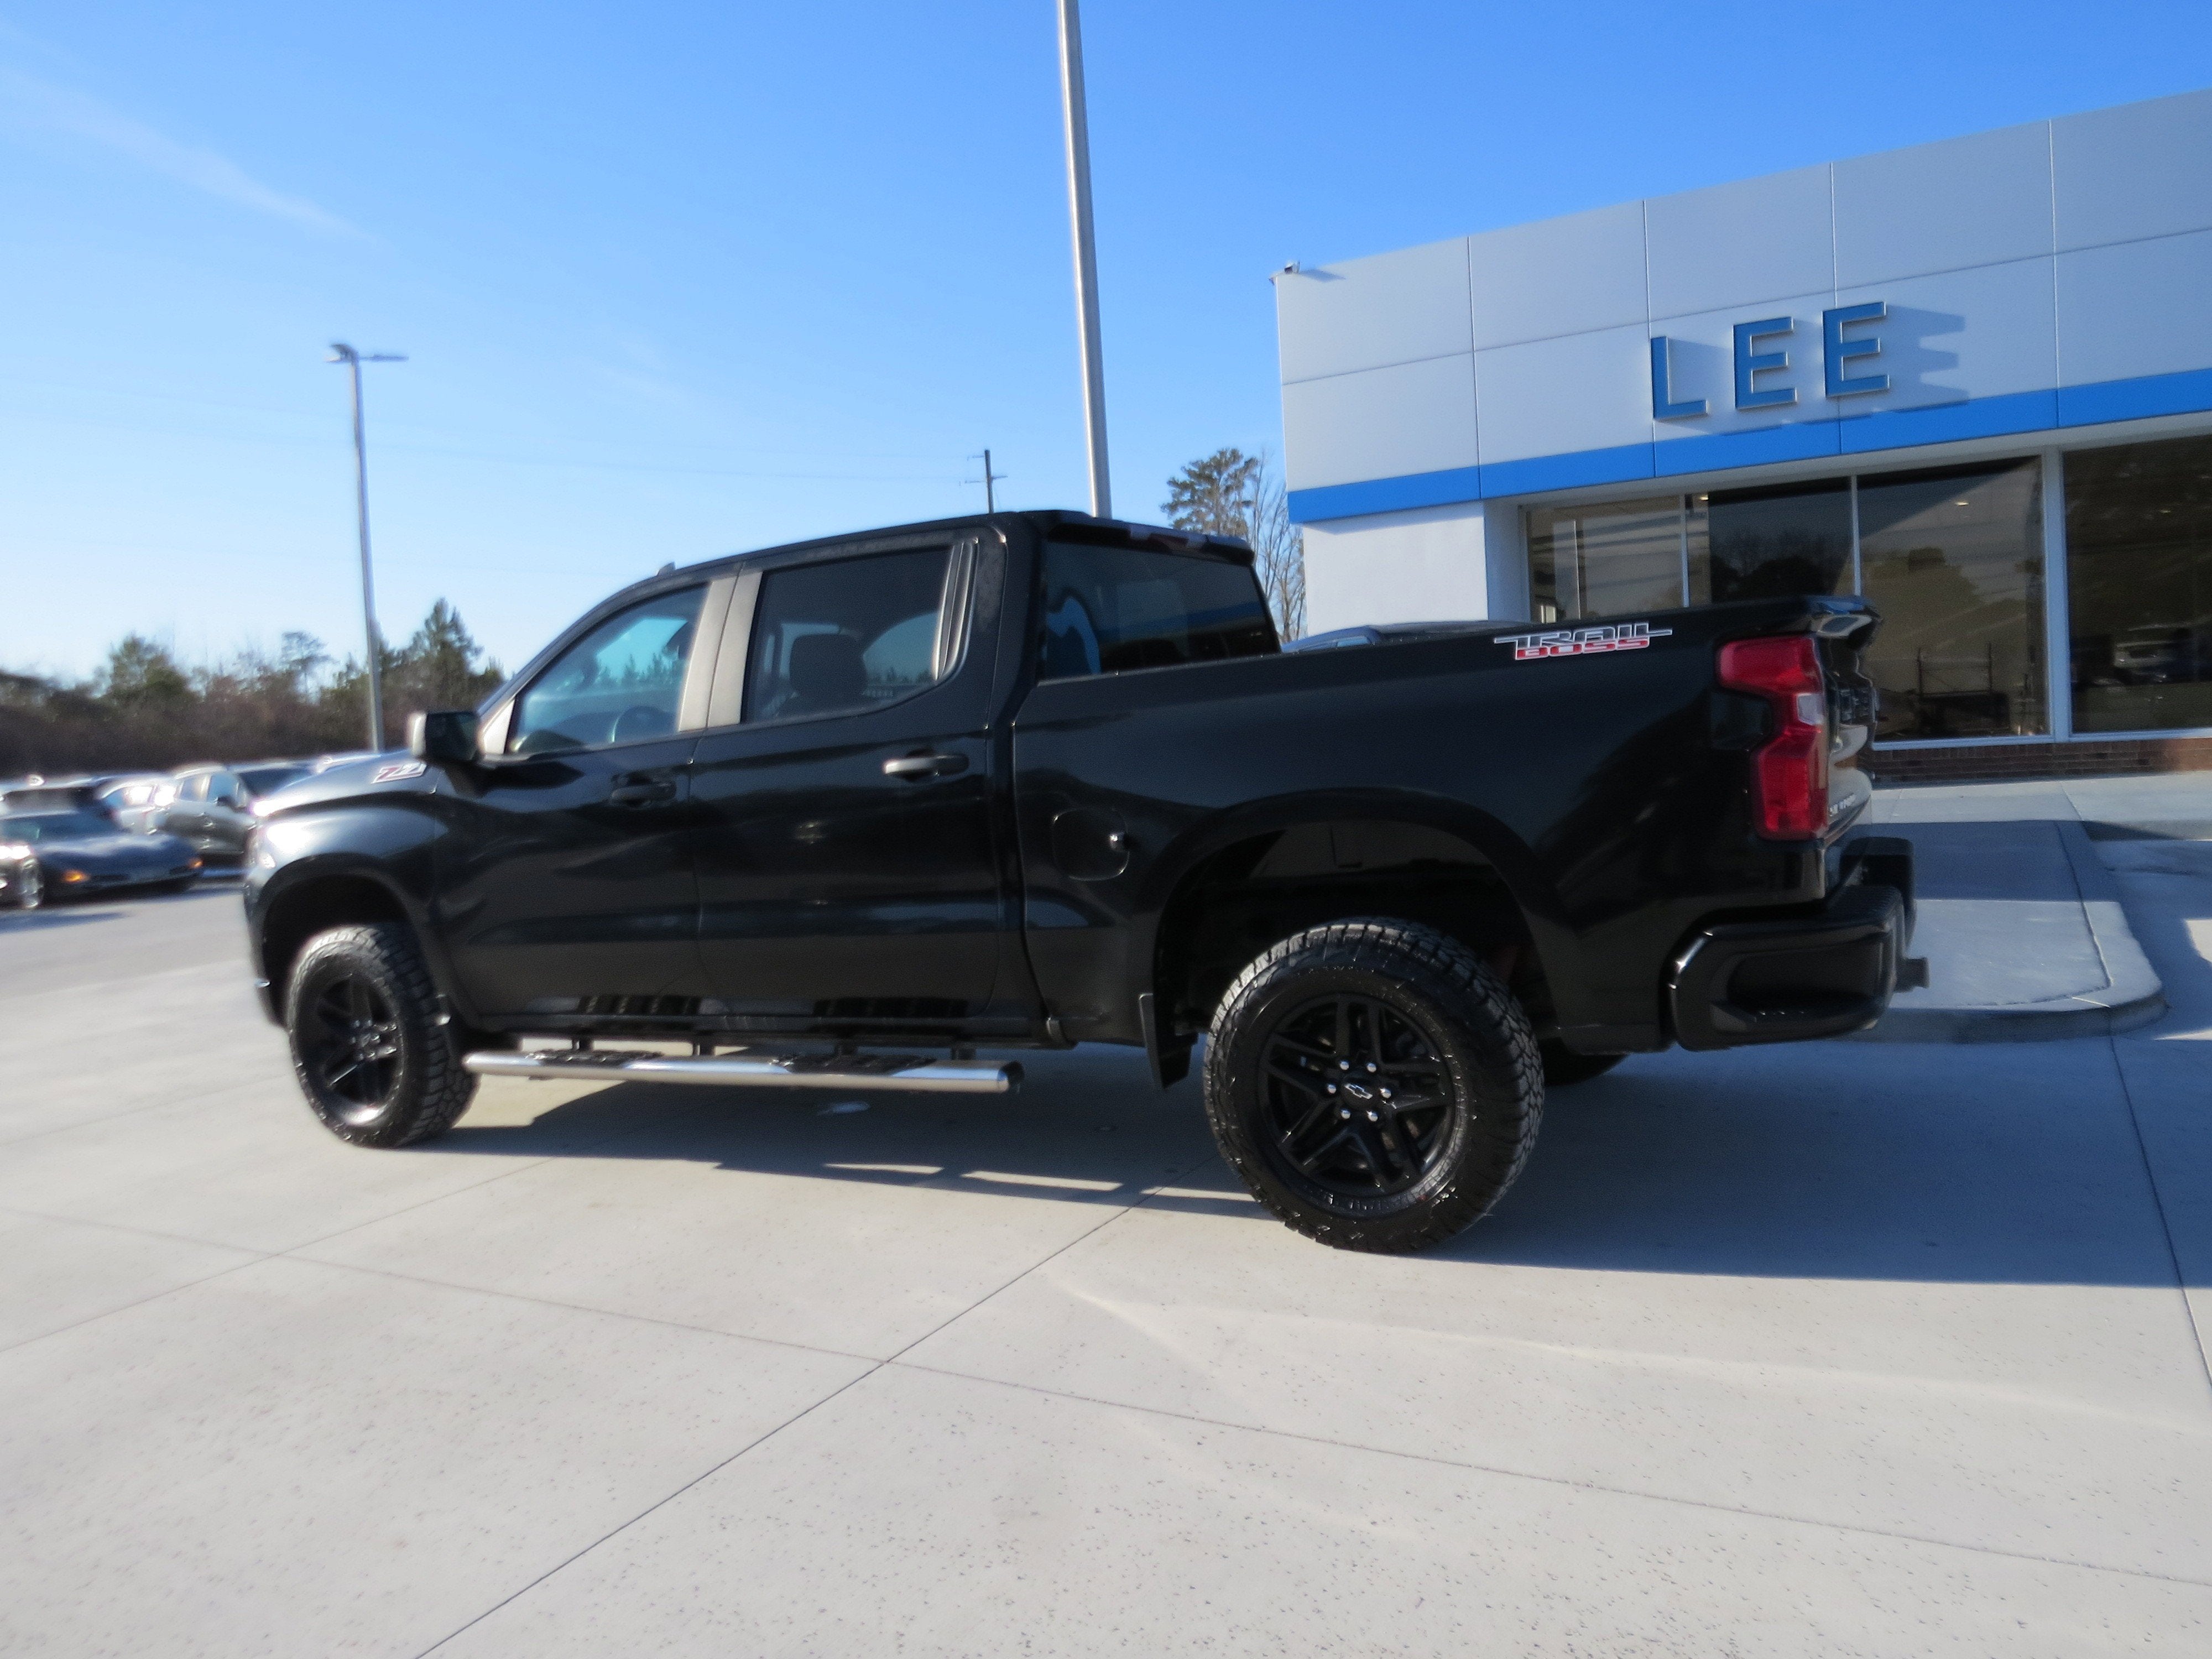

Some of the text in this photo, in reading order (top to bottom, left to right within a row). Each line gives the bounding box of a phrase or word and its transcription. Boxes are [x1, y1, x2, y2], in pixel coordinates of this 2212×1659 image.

[1650, 301, 1890, 420] LEE
[1494, 622, 1672, 648] TRAIL
[1515, 636, 1650, 660] BOSS
